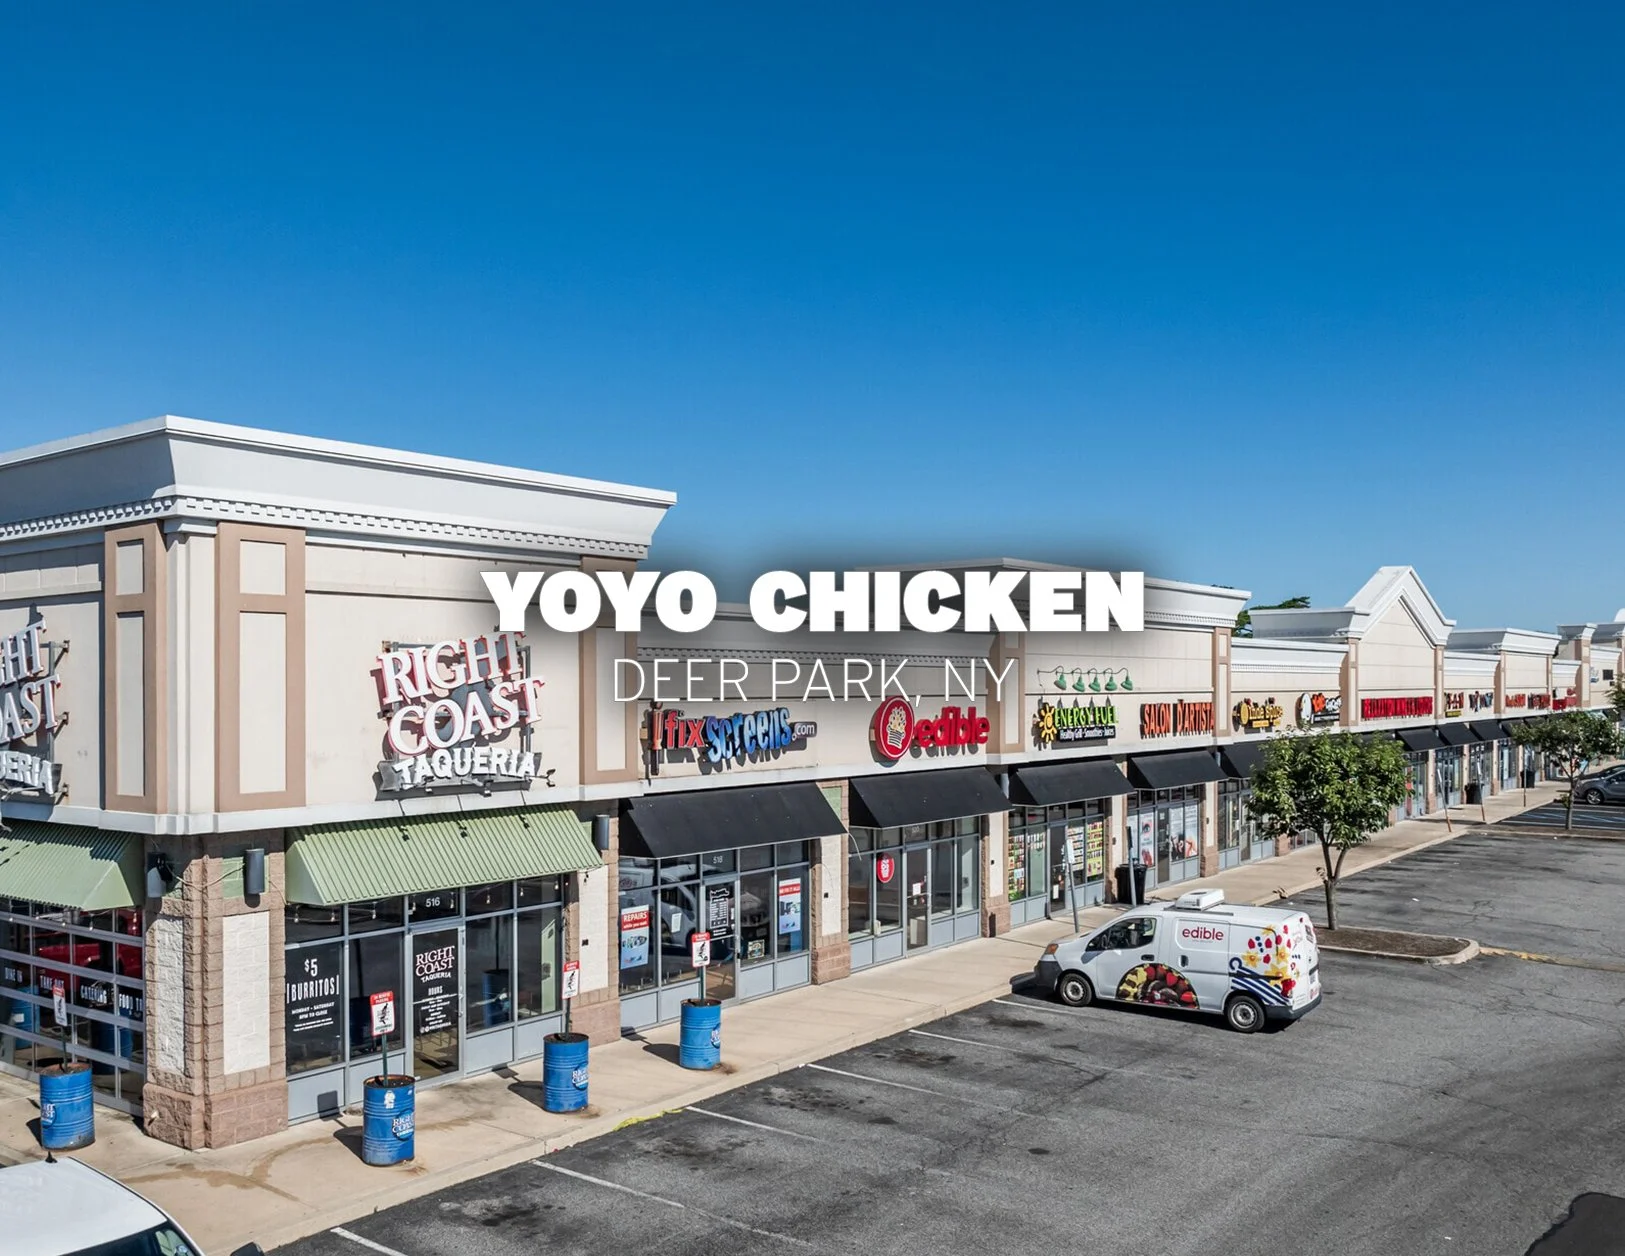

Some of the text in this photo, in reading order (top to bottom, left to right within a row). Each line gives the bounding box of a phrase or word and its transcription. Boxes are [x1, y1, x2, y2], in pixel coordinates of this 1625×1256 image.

[0, 620, 46, 686] HT
[376, 631, 526, 705] RIGHT
[0, 674, 61, 744] AST
[388, 675, 546, 755] COAST
[1054, 705, 1118, 728] ENERGY FUEL
[1143, 703, 1171, 735] SALON
[912, 706, 990, 748] edible
[393, 746, 536, 789] TAQUERIA
[425, 896, 441, 908] 516
[623, 911, 648, 922] REPAIRS
[1182, 926, 1225, 941] edible
[415, 945, 455, 966] RIGHT
[415, 956, 455, 977] COAST
[304, 958, 318, 977] $5
[420, 971, 452, 983] TAQUERIA
[291, 1001, 335, 1015] MONDAY SATURDAY
